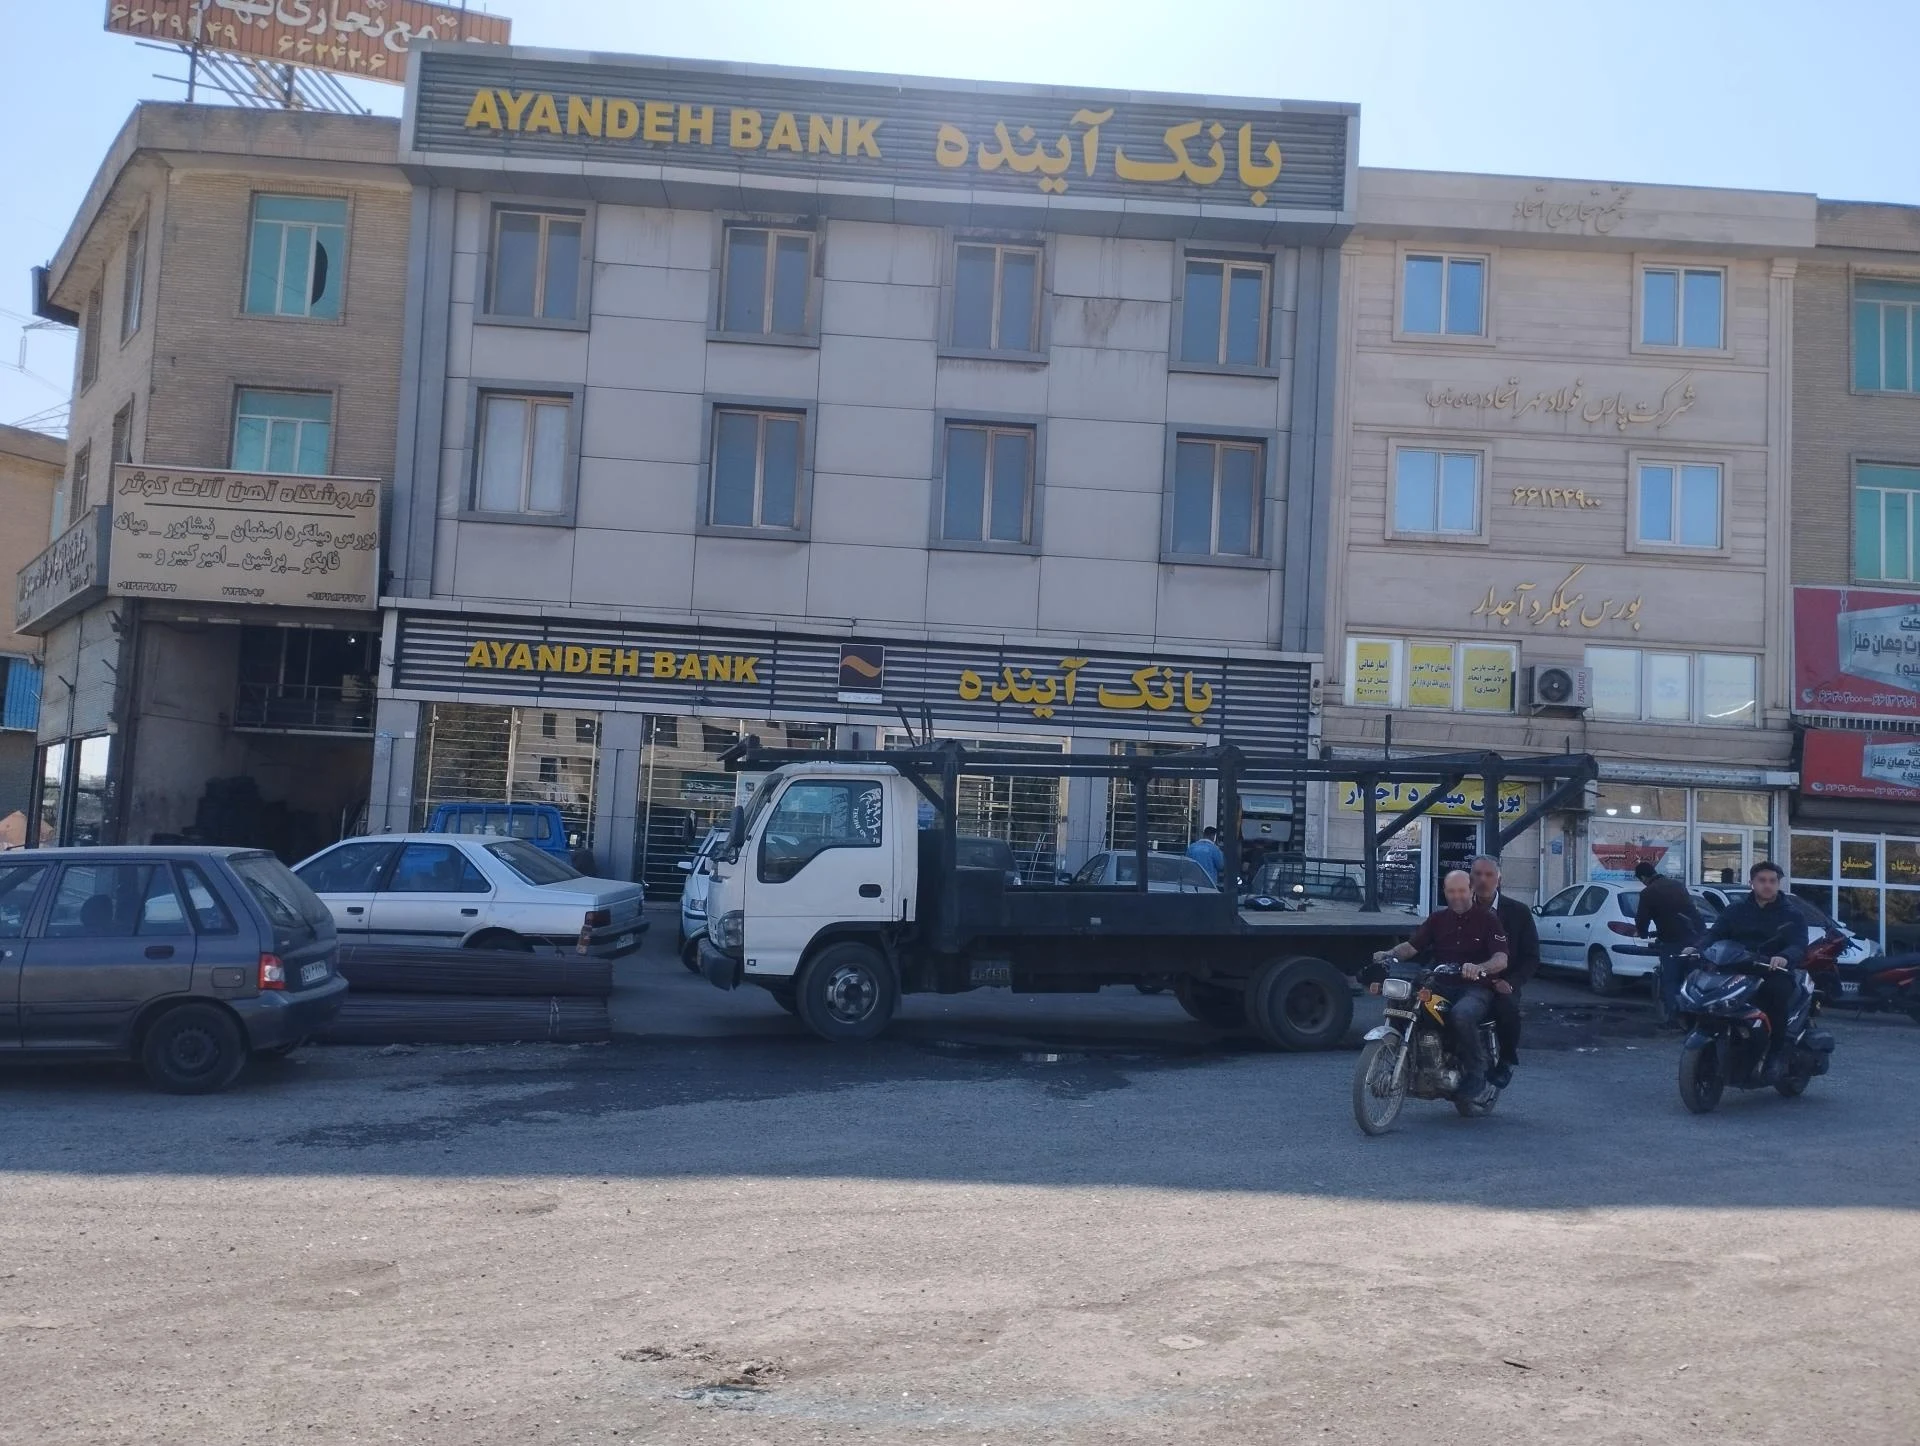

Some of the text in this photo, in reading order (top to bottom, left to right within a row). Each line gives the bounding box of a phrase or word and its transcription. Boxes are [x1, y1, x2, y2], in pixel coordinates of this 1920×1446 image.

[464, 88, 883, 159] AYANDEH BANK
[935, 108, 1282, 207] بانک آینده
[1484, 376, 1521, 409] اتحاد
[1545, 376, 1585, 414] فولاد
[1627, 366, 1697, 430] شرکت
[1582, 391, 1627, 431] پارس
[119, 471, 376, 510] فروشگاه آهن آلات کوثر
[1512, 486, 1601, 509] ۶۶۱۴۴۹۰۰
[114, 511, 149, 536] میانه
[164, 515, 216, 540] نیشابور
[231, 519, 283, 543] اصفهان
[167, 543, 200, 567] کبیر
[334, 531, 377, 551] بورس
[196, 544, 227, 569] امیر
[241, 547, 287, 574] پرشین
[1470, 563, 1643, 632] بورس میلگرد آجدار
[1853, 630, 1871, 652] فلز
[1872, 634, 1902, 658] جهان
[467, 640, 760, 684] AYANDEH BANK
[958, 656, 1213, 727] بانک آینده
